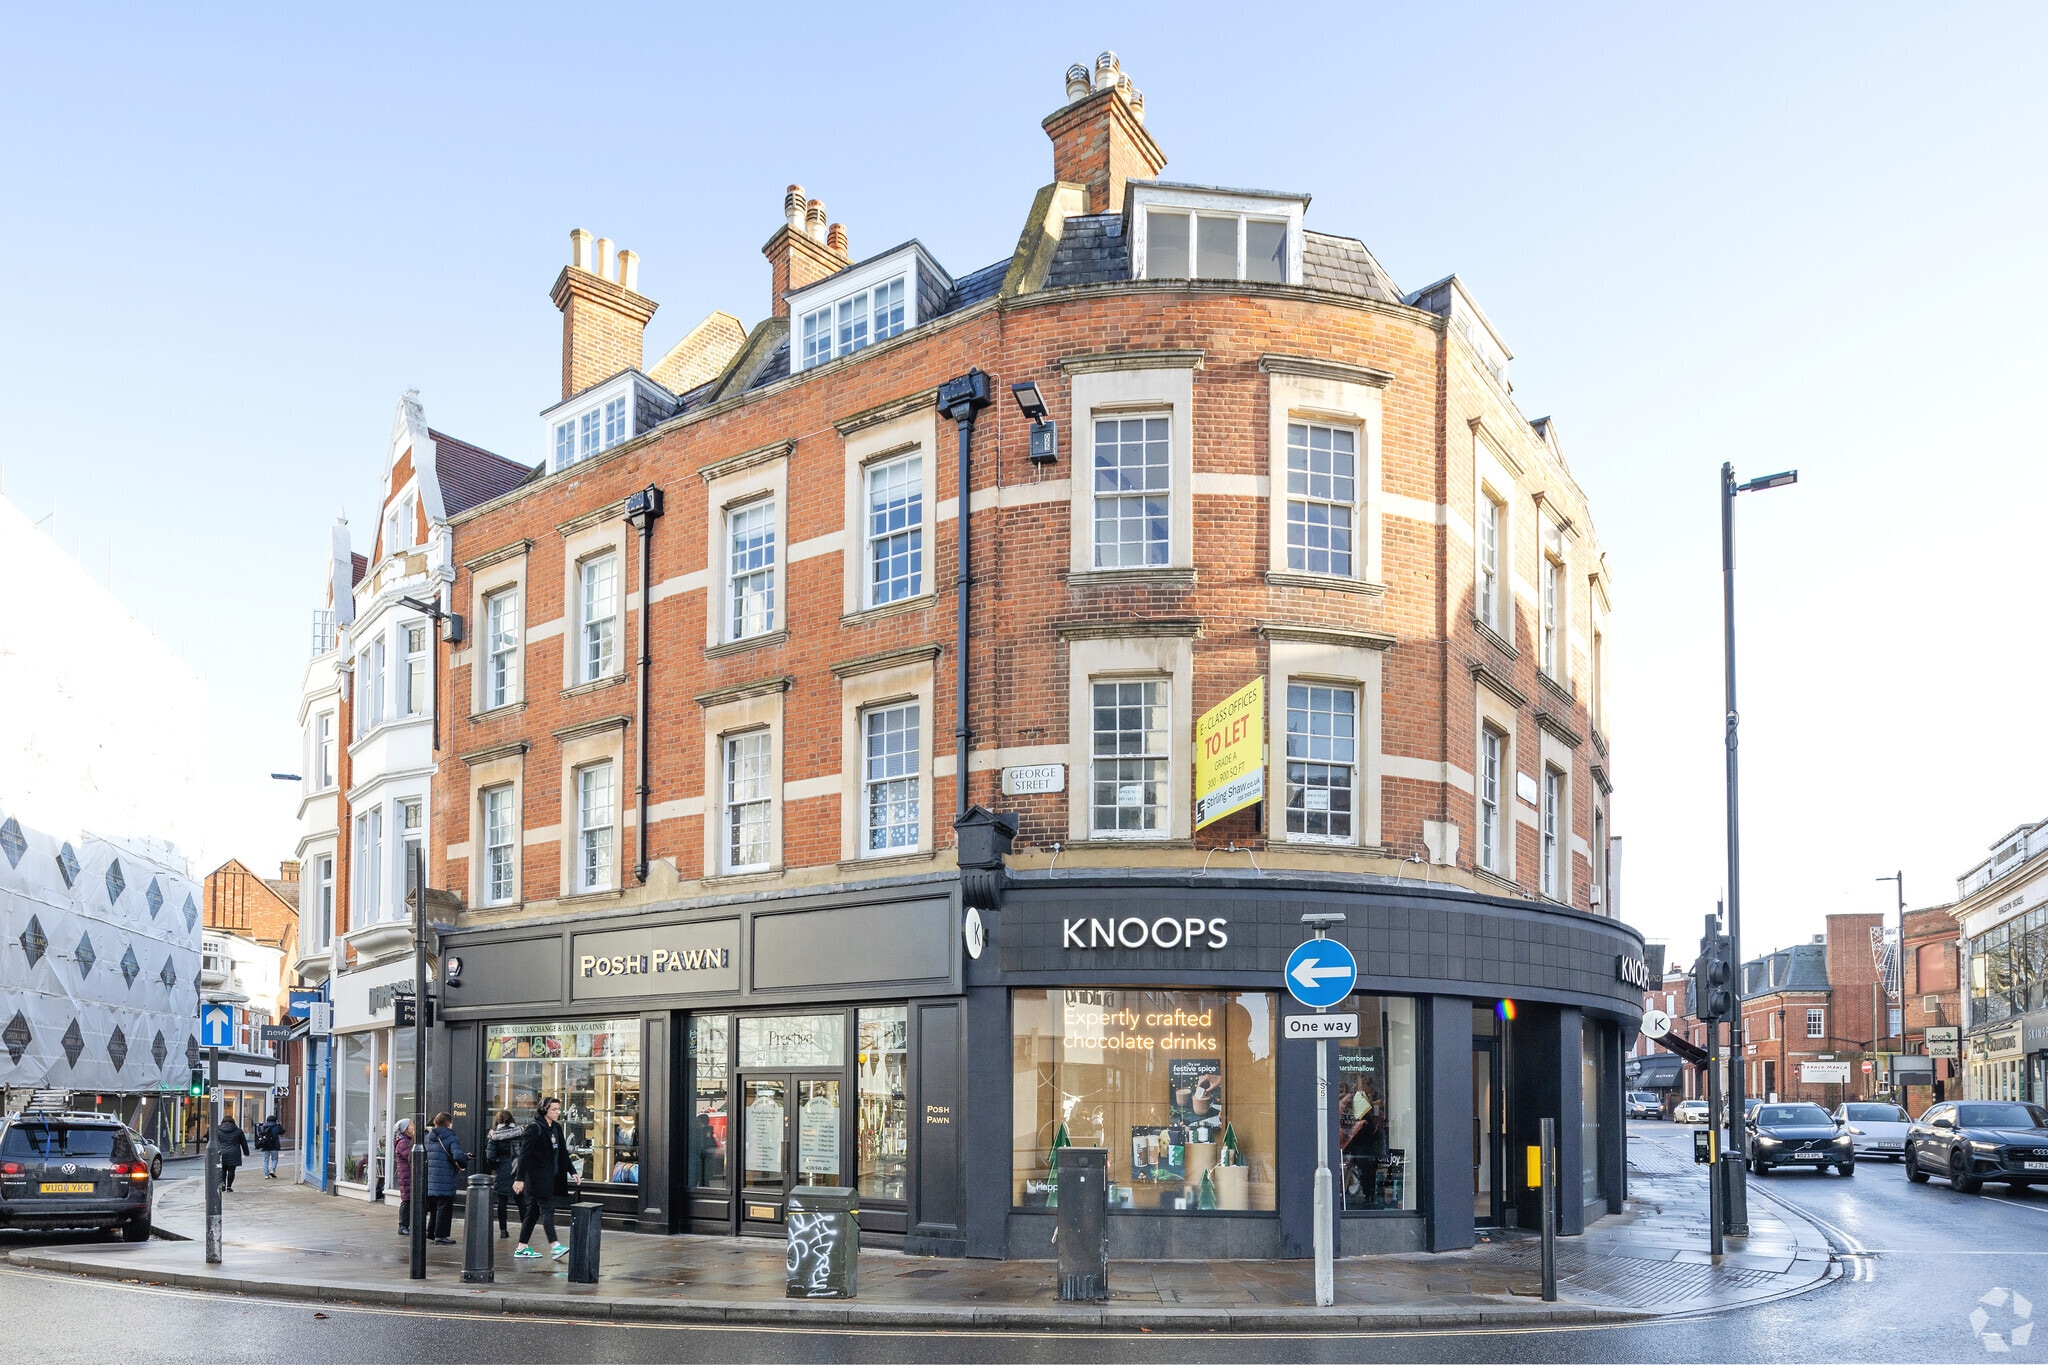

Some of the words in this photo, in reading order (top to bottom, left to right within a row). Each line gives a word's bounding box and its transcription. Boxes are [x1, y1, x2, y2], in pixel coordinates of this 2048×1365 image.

[1207, 707, 1227, 730] CLASS
[1228, 688, 1257, 716] OFFICES
[1205, 732, 1221, 759] TO
[1225, 713, 1249, 749] LET
[1214, 753, 1232, 771] GRADE
[1232, 751, 1238, 761] A
[1010, 768, 1056, 779] GEORGE
[1230, 765, 1238, 778] SQ
[1238, 761, 1246, 773] FT
[1015, 779, 1051, 791] STREET
[1206, 790, 1228, 809] Stirling
[974, 922, 981, 946] K
[1063, 917, 1228, 949] KNOOPS
[580, 955, 643, 977] POSH
[652, 947, 724, 972] PAWN
[1621, 955, 1650, 991] KNOO
[1064, 1008, 1140, 1030] Expertly
[1146, 1008, 1211, 1027] crafted
[1654, 1017, 1666, 1031] K
[512, 1026, 526, 1034] SELL,
[526, 1025, 556, 1033] EXCHANGE
[563, 1024, 579, 1032] LOAN
[580, 1023, 606, 1031] AGAINST
[1290, 1021, 1318, 1032] One
[1324, 1022, 1352, 1033] way
[1063, 1031, 1155, 1050] chocolate
[1160, 1032, 1217, 1050] drinks
[1197, 1065, 1217, 1073] spice
[211, 1087, 218, 1095] S
[1320, 1082, 1326, 1090] S
[211, 1094, 218, 1102] 2
[1320, 1089, 1326, 1097] 5
[927, 1105, 950, 1113] POSH
[926, 1116, 950, 1124] PAWN
[1389, 1153, 1401, 1166] joy
[72, 1184, 90, 1192] YKG
[1036, 1182, 1058, 1192] Happ
